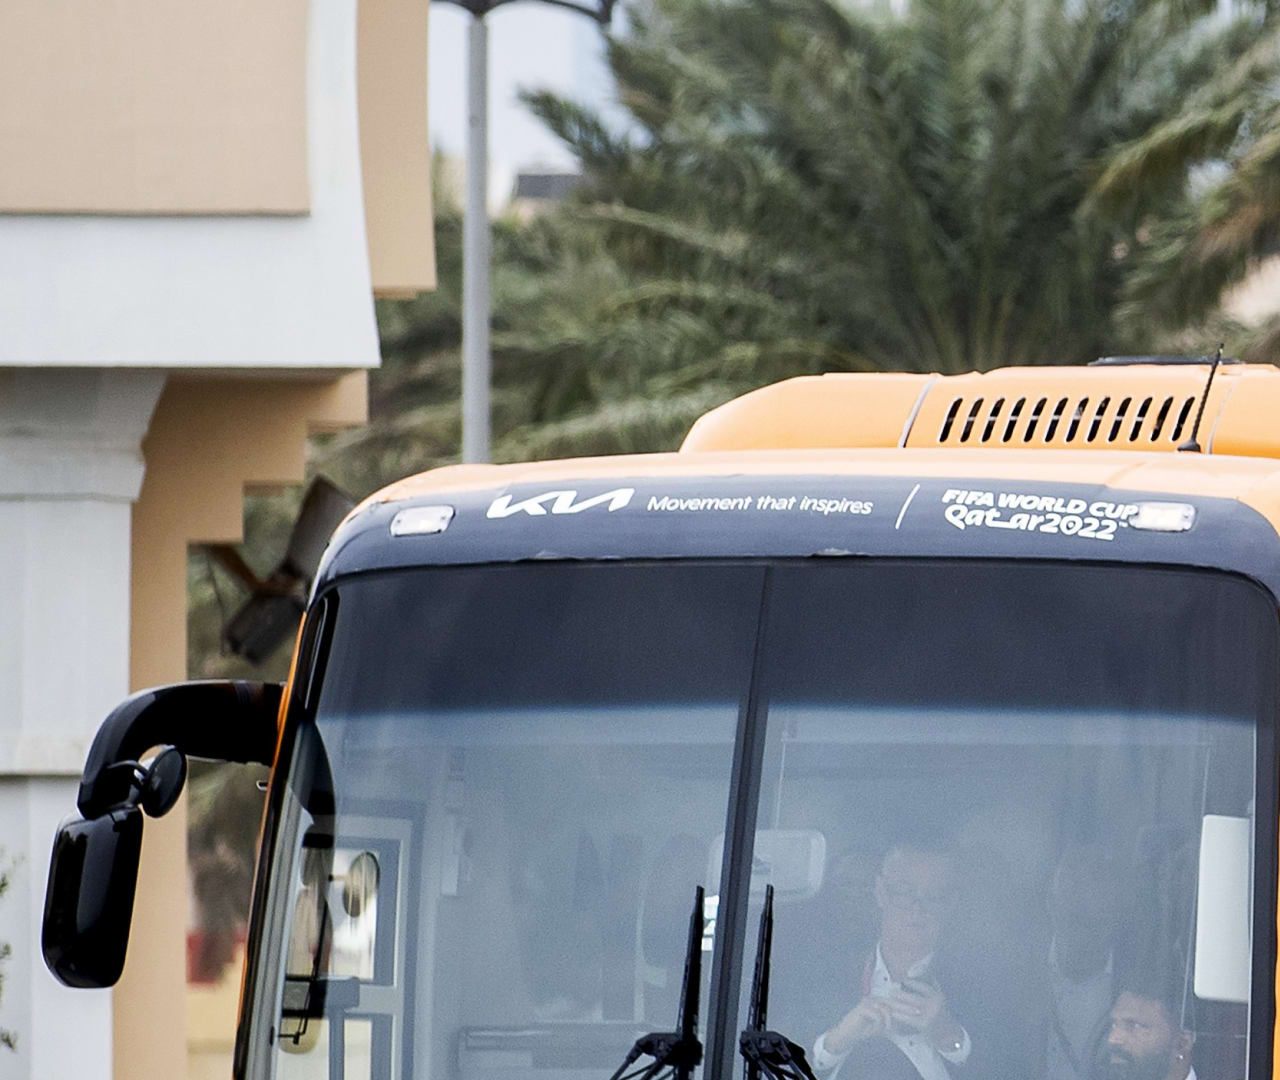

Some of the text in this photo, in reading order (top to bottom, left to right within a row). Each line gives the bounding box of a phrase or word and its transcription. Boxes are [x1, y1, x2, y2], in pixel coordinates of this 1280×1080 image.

[647, 495, 874, 516] Movement that inspires
[941, 488, 1139, 520] FIFA WORLD CUP
